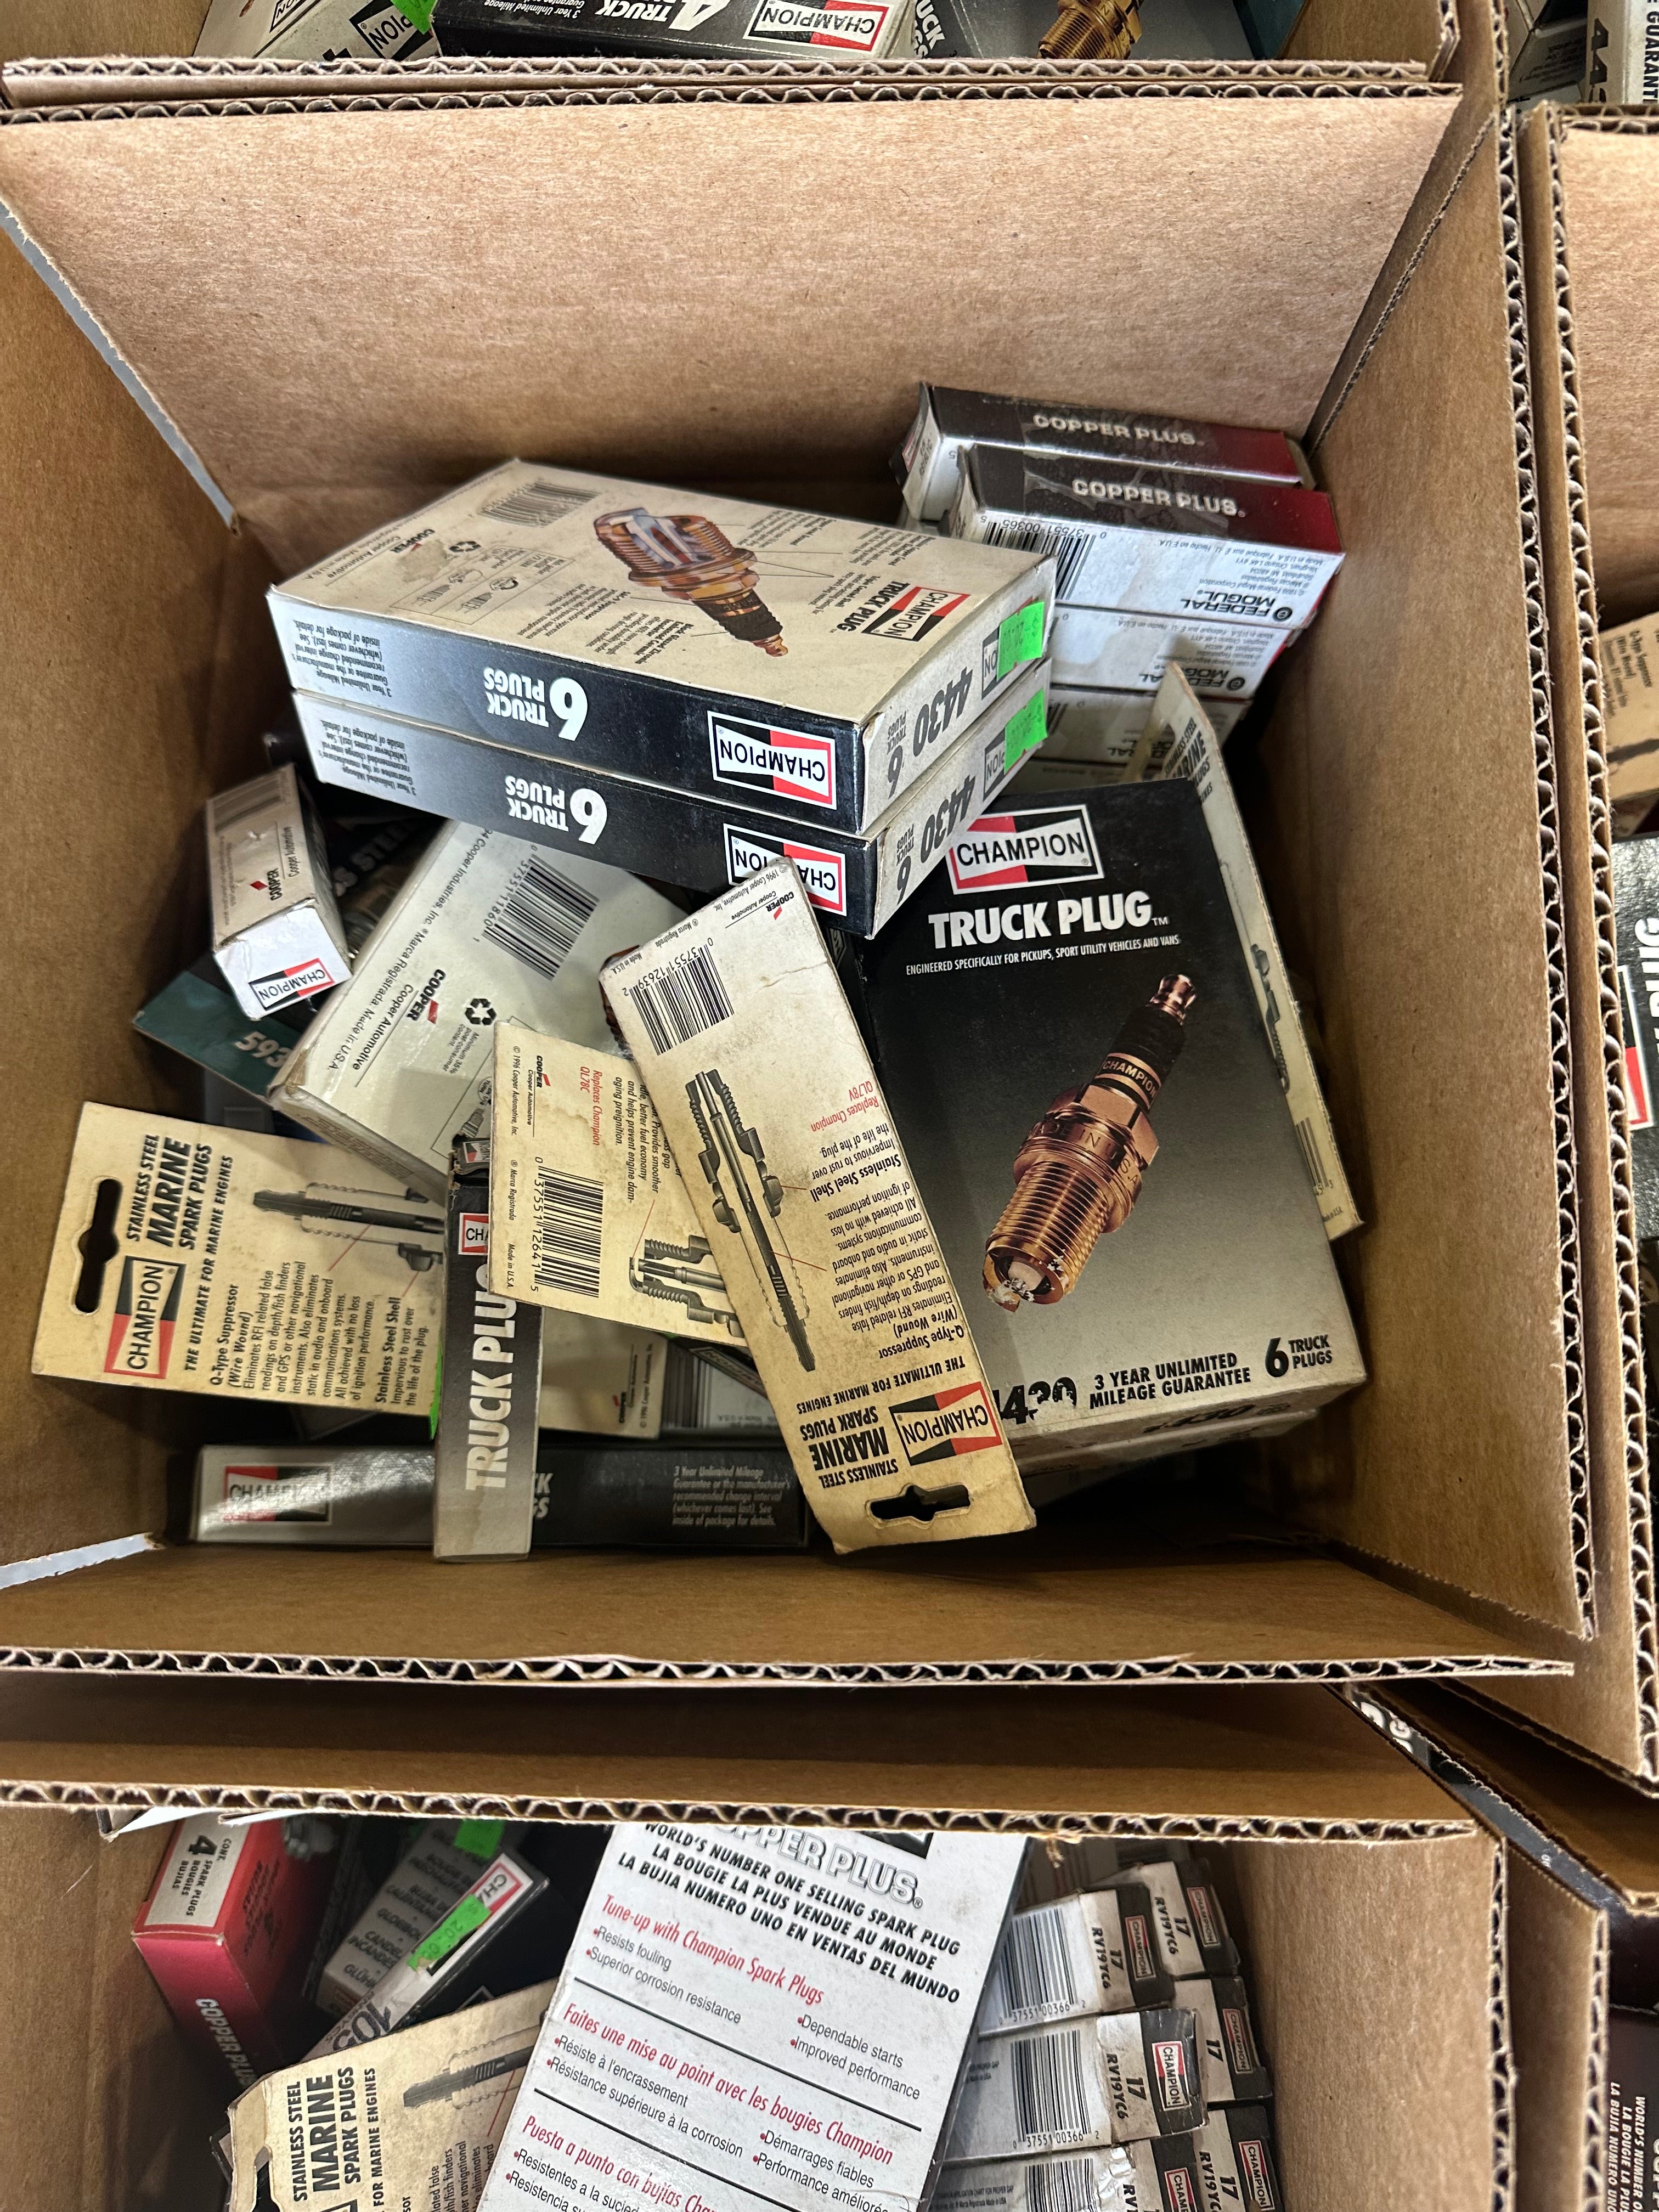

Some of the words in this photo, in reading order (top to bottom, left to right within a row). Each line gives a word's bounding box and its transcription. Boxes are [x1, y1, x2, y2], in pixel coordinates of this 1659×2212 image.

[516, 2, 552, 16] Unlimited
[554, 7, 572, 19] Year
[572, 10, 581, 19] 3
[595, 0, 669, 22] TRUCK
[761, 7, 877, 35] CHAMPION
[1643, 11, 1659, 103] GUARANT
[1032, 414, 1130, 437] COPPER
[1133, 427, 1195, 444] PLUS
[1072, 479, 1171, 505] COPPER
[1176, 492, 1237, 515] PLUS
[864, 581, 911, 609] TRUCK
[1180, 599, 1270, 617] FEDERAL
[1204, 591, 1276, 610] MOGUL
[837, 607, 877, 632] PLUG
[884, 592, 949, 637] CHAMPION
[483, 667, 544, 702] PLUGS
[485, 691, 554, 727] TRUCK
[541, 677, 588, 741] 6
[913, 667, 973, 757] 4430
[716, 739, 829, 781] CHAMPION
[888, 745, 903, 799] 6
[505, 776, 565, 809] PLUGS
[506, 797, 568, 831] TRUCK
[569, 788, 607, 844] 6
[921, 775, 975, 863] 4430
[957, 829, 1085, 866] CHAMPION
[266, 868, 284, 902] COOPER
[735, 849, 836, 891] CHAION
[897, 856, 911, 906] 6
[928, 901, 1051, 949] TRUCK
[1057, 891, 1151, 934] PLUG
[401, 932, 425, 958] Marca
[906, 961, 952, 975] ENGINEERED
[954, 955, 1002, 969] SPECIFICALLY
[1004, 952, 1019, 963] FOR
[1020, 949, 1053, 962] PICKUPS,
[1055, 946, 1078, 958] SPORT
[1080, 943, 1106, 955] UTILITY
[1108, 939, 1141, 951] VEHICLES
[1143, 937, 1159, 947] AND
[1159, 934, 1179, 945] VANS
[258, 966, 325, 1002] CHAMPION
[369, 957, 407, 1005] Registrada.
[407, 969, 444, 1020] COOPER
[345, 1034, 358, 1043] in
[352, 1008, 375, 1034] Made
[327, 1045, 351, 1070] U.S.A.
[534, 1055, 544, 1088] COOPER
[580, 1066, 590, 1093] QL78C
[591, 1070, 603, 1103] Replaces
[848, 1081, 873, 1101] QL78V
[1102, 1059, 1157, 1098] CHAMPION
[810, 1110, 847, 1132] Champion
[847, 1096, 879, 1116] Replaces
[590, 1105, 603, 1146] Champion
[188, 1143, 211, 1194] PLUGS
[834, 1172, 859, 1192] Steel
[859, 1154, 901, 1178] Stainless
[125, 1171, 151, 1242] STAINLESS
[139, 1135, 159, 1170] STEEL
[145, 1137, 191, 1248] MARINE
[810, 1182, 834, 1201] Shell
[178, 1196, 202, 1250] SPARK
[126, 1265, 164, 1369] CHAMPION
[472, 1263, 517, 1363] PLU
[893, 1317, 929, 1339] Wound)
[930, 1305, 957, 1323] (Wire
[930, 1320, 964, 1341] Q-Type
[878, 1335, 930, 1359] Suppressor
[1265, 1337, 1289, 1378] 6
[1288, 1334, 1330, 1353] TRUCK
[1292, 1350, 1333, 1369] PLUGS
[893, 1362, 943, 1387] ULTIMATE
[944, 1355, 965, 1372] THE
[1094, 1374, 1104, 1390] 3
[1109, 1367, 1150, 1387] YEAR
[1155, 1352, 1237, 1379] UNLIMITED
[832, 1384, 870, 1404] MARINE
[871, 1377, 891, 1393] FOR
[1090, 1383, 1156, 1409] MILEAGE
[1161, 1367, 1251, 1396] GUARANTEE
[796, 1395, 832, 1414] ENGINES
[836, 1406, 878, 1431] SPARK
[465, 1370, 512, 1490] TRUCK
[799, 1417, 837, 1441] PLUGS
[901, 1401, 988, 1448] CHAMPION
[808, 1426, 889, 1471] MARINE
[818, 1470, 846, 1488] STEEL
[846, 1458, 899, 1483] STAINLESS
[187, 1835, 217, 1855] 4
[216, 1838, 232, 1861] CONT.
[172, 1860, 189, 1888] BUJIAS
[181, 1860, 200, 1895] BOUGIES
[195, 1859, 212, 1886] SPARK
[645, 1822, 708, 1852] WORLD'S
[709, 1844, 771, 1880] NUMBER
[774, 1871, 805, 1893] ONE
[806, 1884, 865, 1916] SELLING
[867, 1908, 918, 1938] SPARK
[919, 1929, 960, 1955] PLUG
[825, 1842, 918, 1904] PLUS
[185, 1889, 201, 1916] PLUGS
[652, 1843, 670, 1861] LA
[673, 1852, 729, 1884] BOUGIE
[730, 1876, 749, 1894] LA
[752, 1884, 789, 1909] PLUS
[793, 1900, 851, 1936] VENDUE
[853, 1927, 877, 1945] AU
[879, 1937, 937, 1970] MONDE
[618, 1852, 635, 1870] LA
[639, 1861, 680, 1889] BUJIA
[684, 1880, 747, 1915] NUMERO
[751, 1907, 782, 1931] UNO
[786, 1922, 808, 1942] EN
[811, 1932, 866, 1965] VENTAS
[869, 1956, 896, 1979] DEL
[900, 1969, 960, 2003] MUNDO
[602, 1894, 650, 1932] Tune-up
[653, 1921, 679, 1943] with
[682, 1930, 744, 1971] Champion
[746, 1957, 786, 1988] Spark
[787, 1974, 824, 2005] Plugs
[1092, 1927, 1111, 1989] RV19YC6
[1109, 1949, 1124, 1971] 17
[801, 2013, 868, 2053] Dependable
[871, 2046, 903, 2068] starts
[1205, 2039, 1223, 2062] 17
[563, 2002, 600, 2033] Faites
[601, 2025, 625, 2046] une
[627, 2038, 657, 2061] mise
[659, 2053, 678, 2070] au
[677, 2062, 714, 2086] point
[715, 2078, 747, 2102] avec
[747, 2085, 768, 2111] les
[770, 2095, 822, 2134] bougies
[826, 2121, 893, 2164] Champion
[1105, 2053, 1128, 2120] RV19YC6
[1126, 2077, 1147, 2100] 17
[1163, 2045, 1181, 2106] CHAMPION
[287, 2081, 302, 2122] STEEL
[337, 2067, 356, 2122] PLUGS
[306, 2074, 340, 2192] MARINE
[1634, 2096, 1645, 2147] WORLD'S
[289, 2126, 307, 2202] STAINLESS
[341, 2126, 360, 2184] SPARK
[1220, 2176, 1239, 2200] 17
[1248, 2146, 1266, 2206] CHAMPION
[1633, 2148, 1643, 2198] NUMBER
